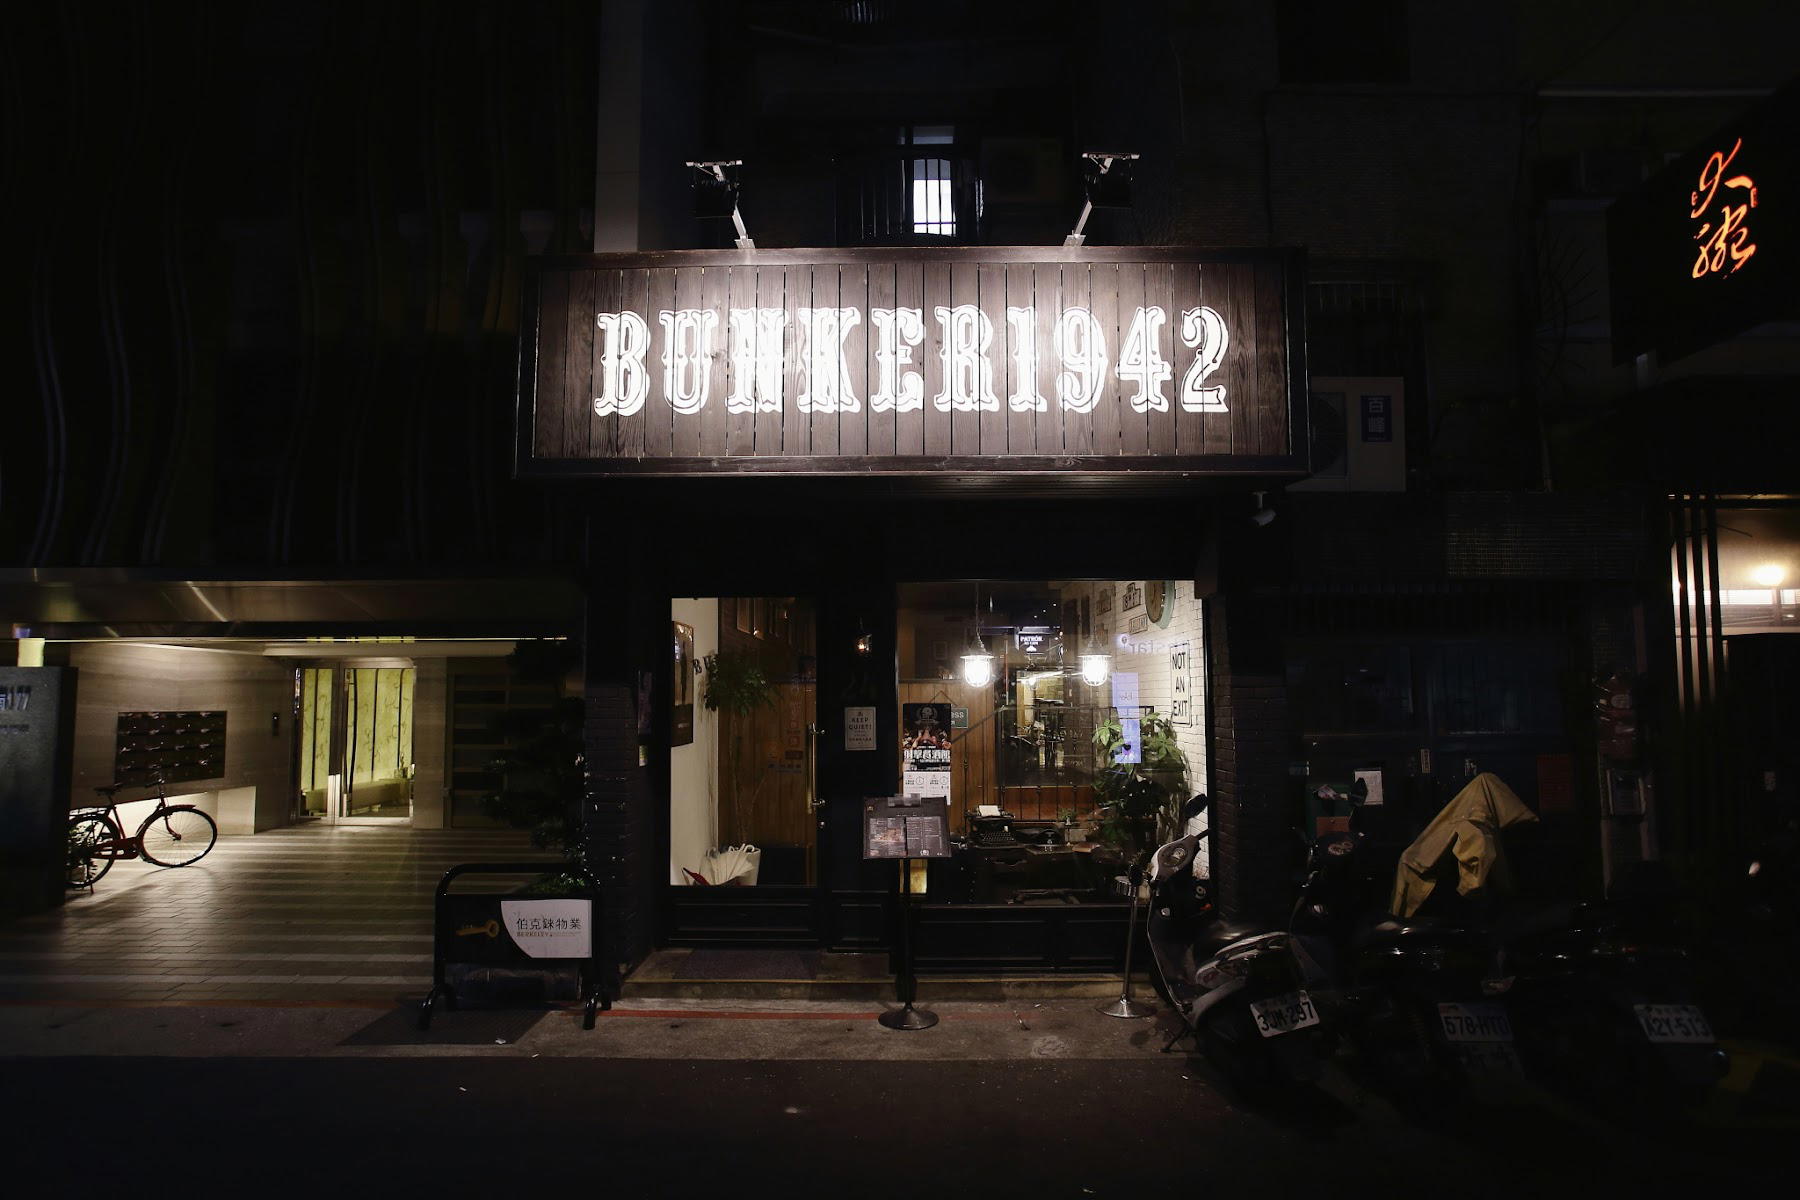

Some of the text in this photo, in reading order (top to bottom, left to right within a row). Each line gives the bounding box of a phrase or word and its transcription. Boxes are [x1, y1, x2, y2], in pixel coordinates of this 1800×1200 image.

[594, 304, 1229, 416] BUNKER1942
[1172, 652, 1186, 670] NOT
[1175, 676, 1185, 693] AN
[1173, 700, 1187, 717] EXIT
